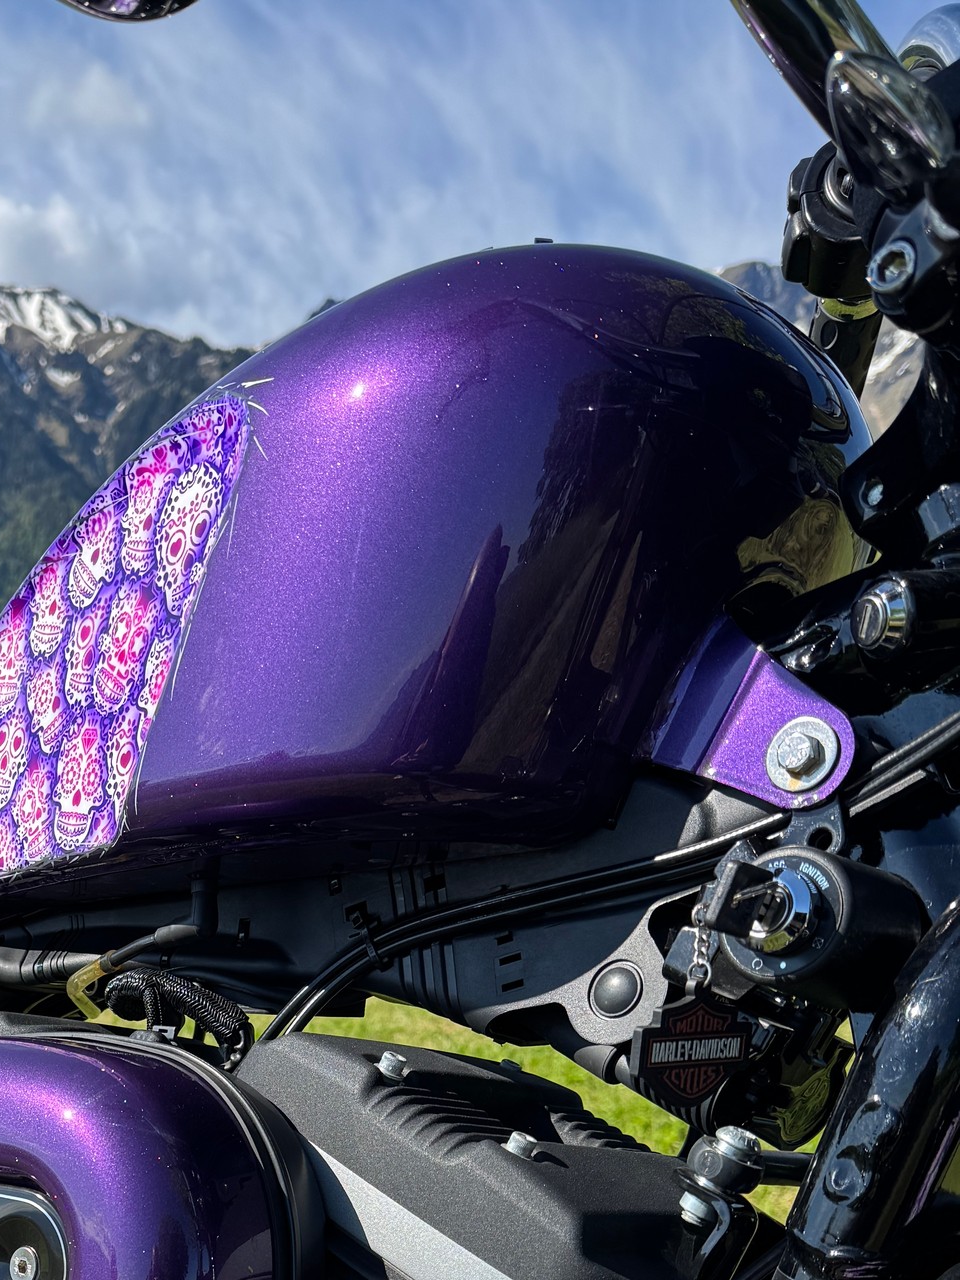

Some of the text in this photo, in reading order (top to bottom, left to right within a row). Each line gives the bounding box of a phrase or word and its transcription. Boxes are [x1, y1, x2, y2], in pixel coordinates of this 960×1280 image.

[799, 862, 830, 890] IGNITION
[676, 1009, 721, 1033] MOTOR
[651, 1037, 740, 1063] HARLEY-DAVIDSON
[671, 1067, 716, 1093] CYCLES
